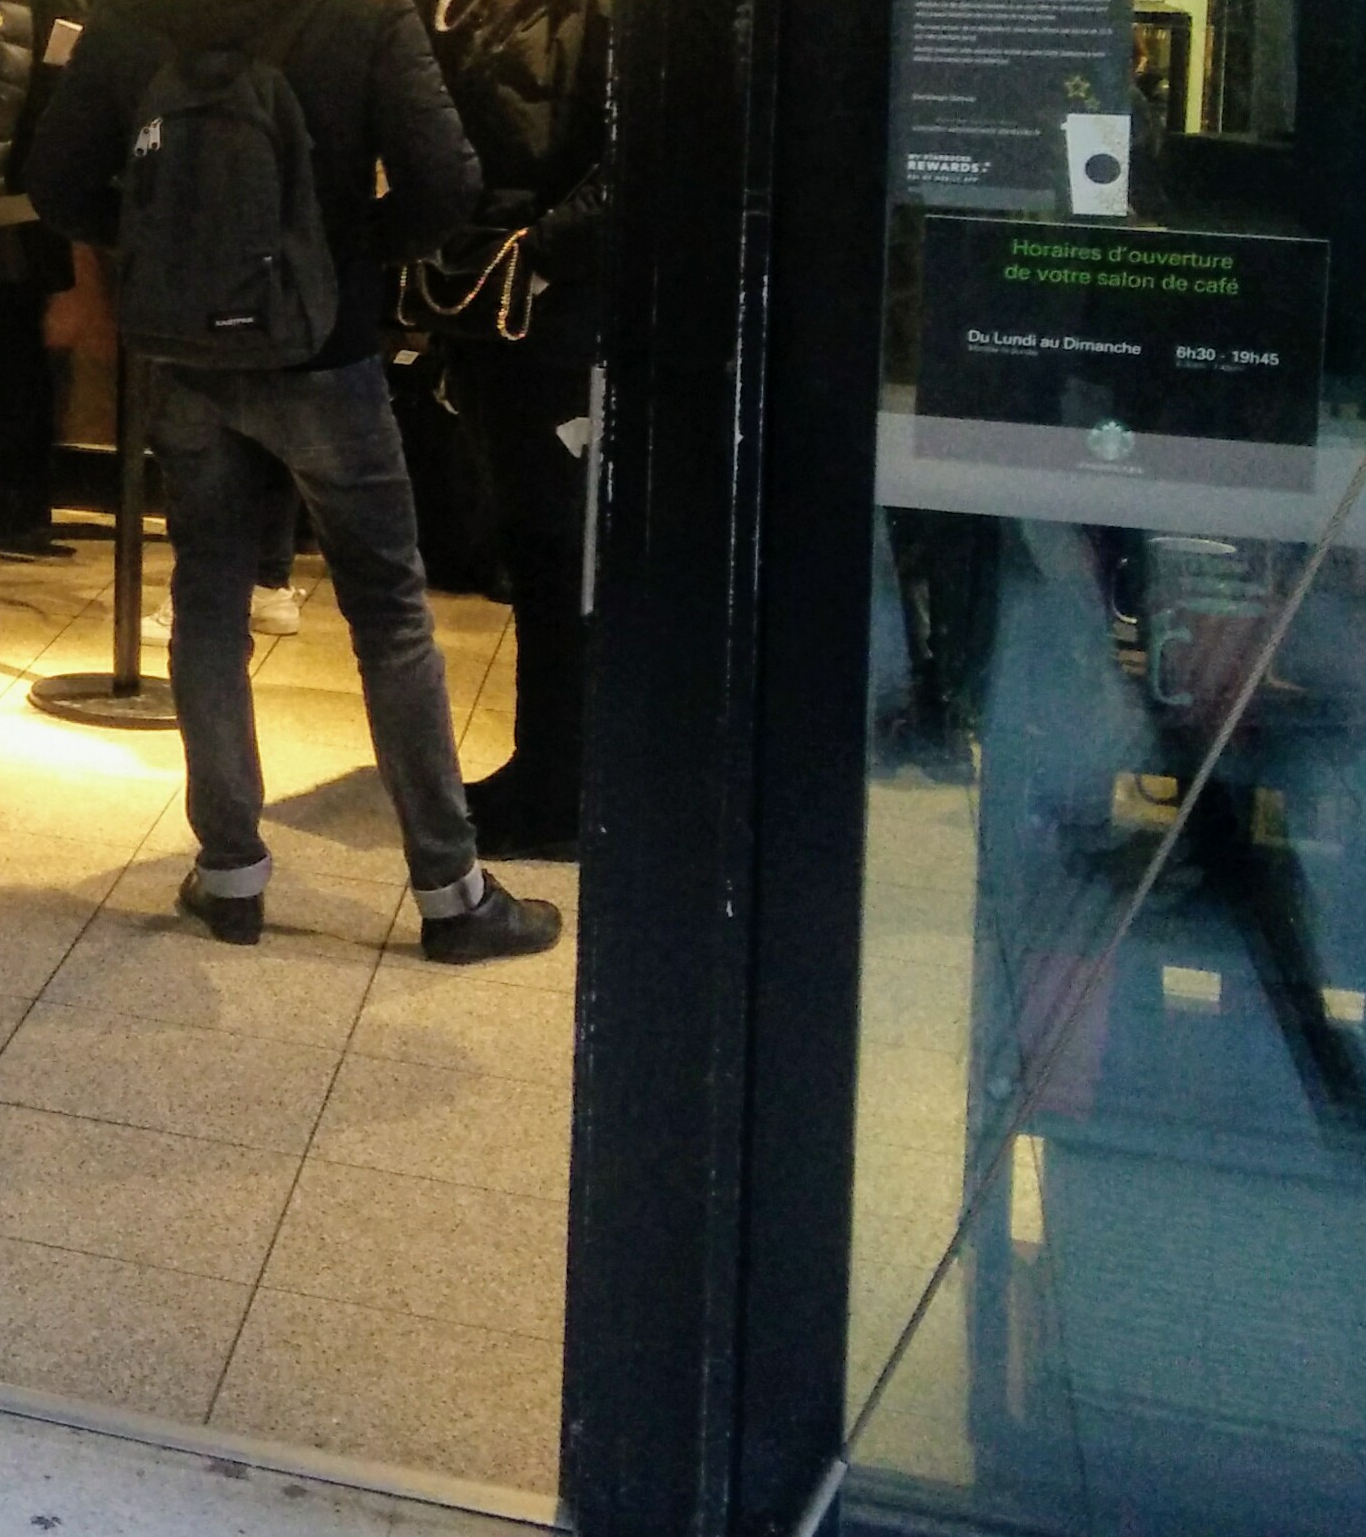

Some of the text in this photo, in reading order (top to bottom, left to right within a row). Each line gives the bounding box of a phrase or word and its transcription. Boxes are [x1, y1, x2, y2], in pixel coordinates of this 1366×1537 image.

[907, 160, 980, 173] REWARDS
[1011, 238, 1102, 262] Horaires
[1004, 263, 1239, 296] de votre salon de café
[967, 329, 990, 344] Du
[993, 330, 1037, 347] Lundi
[1040, 337, 1060, 349] au
[1063, 336, 1142, 356] Dimanche
[1176, 345, 1216, 362] 6h30
[1231, 349, 1280, 366] 19h45
